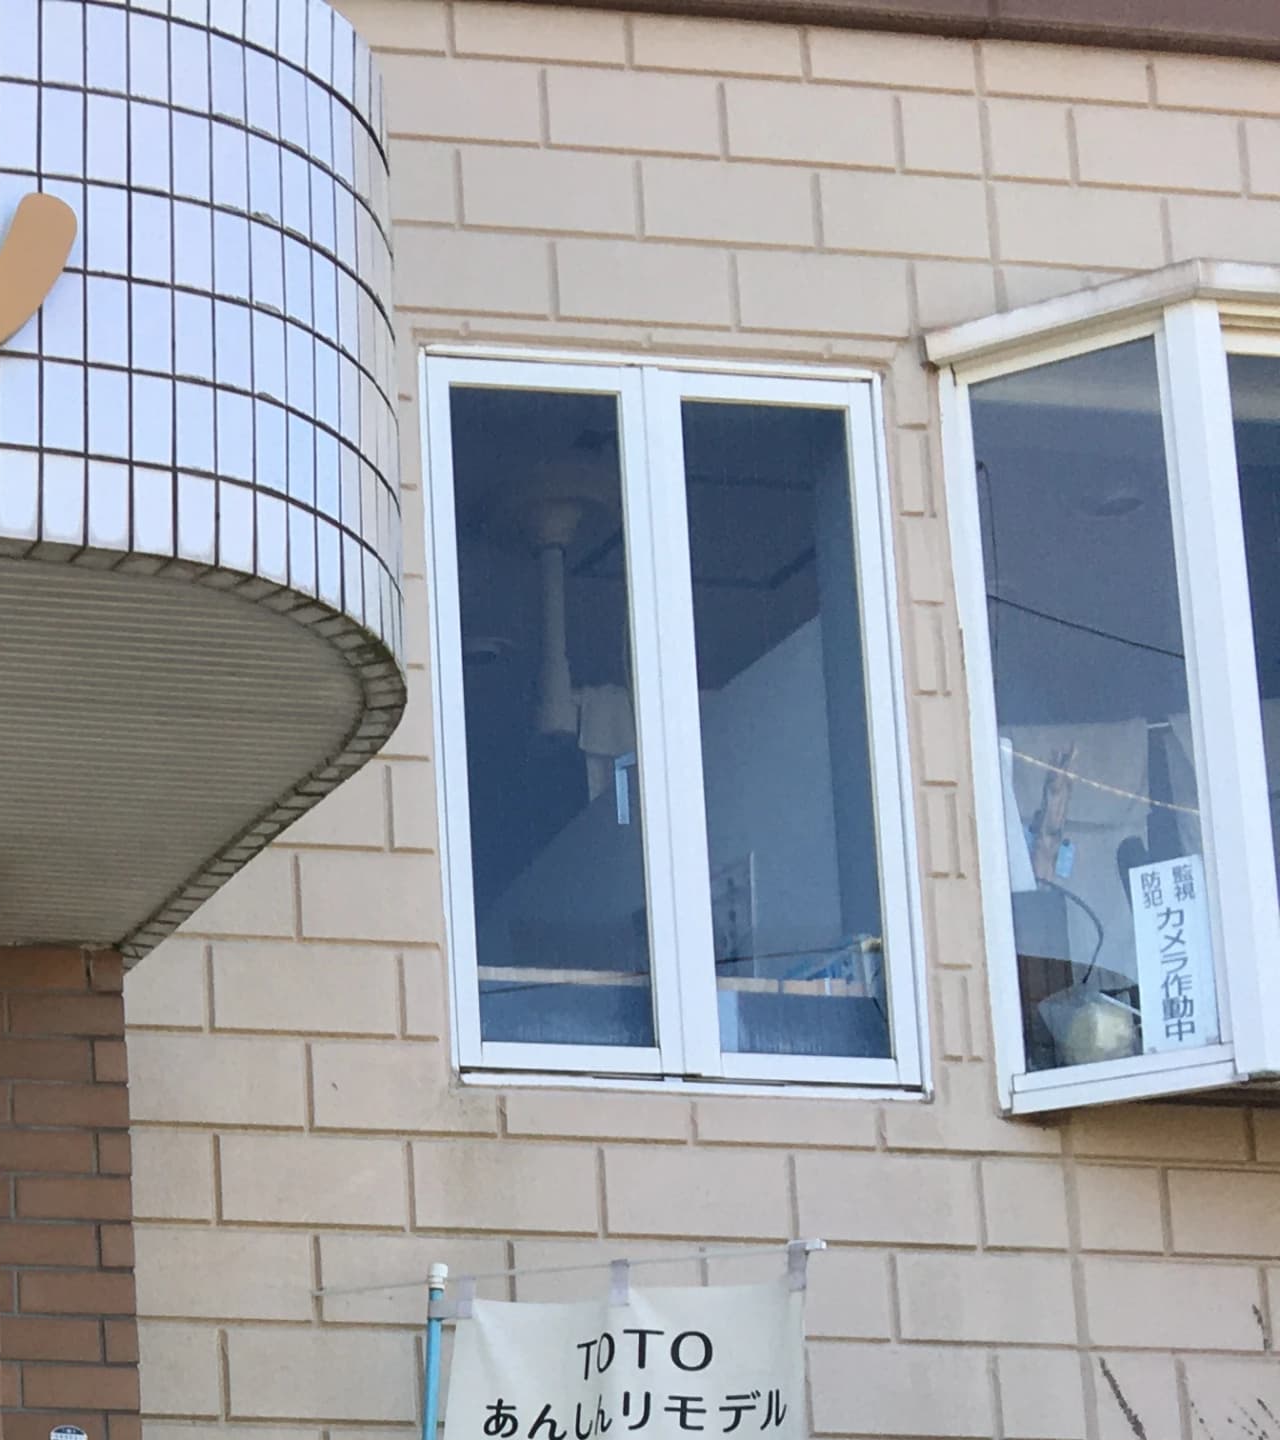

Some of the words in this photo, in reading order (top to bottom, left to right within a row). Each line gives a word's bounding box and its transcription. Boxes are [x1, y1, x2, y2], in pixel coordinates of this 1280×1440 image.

[1171, 864, 1196, 902] 監視
[1157, 907, 1196, 1042] カメラ作動中
[577, 1328, 714, 1382] TOTO
